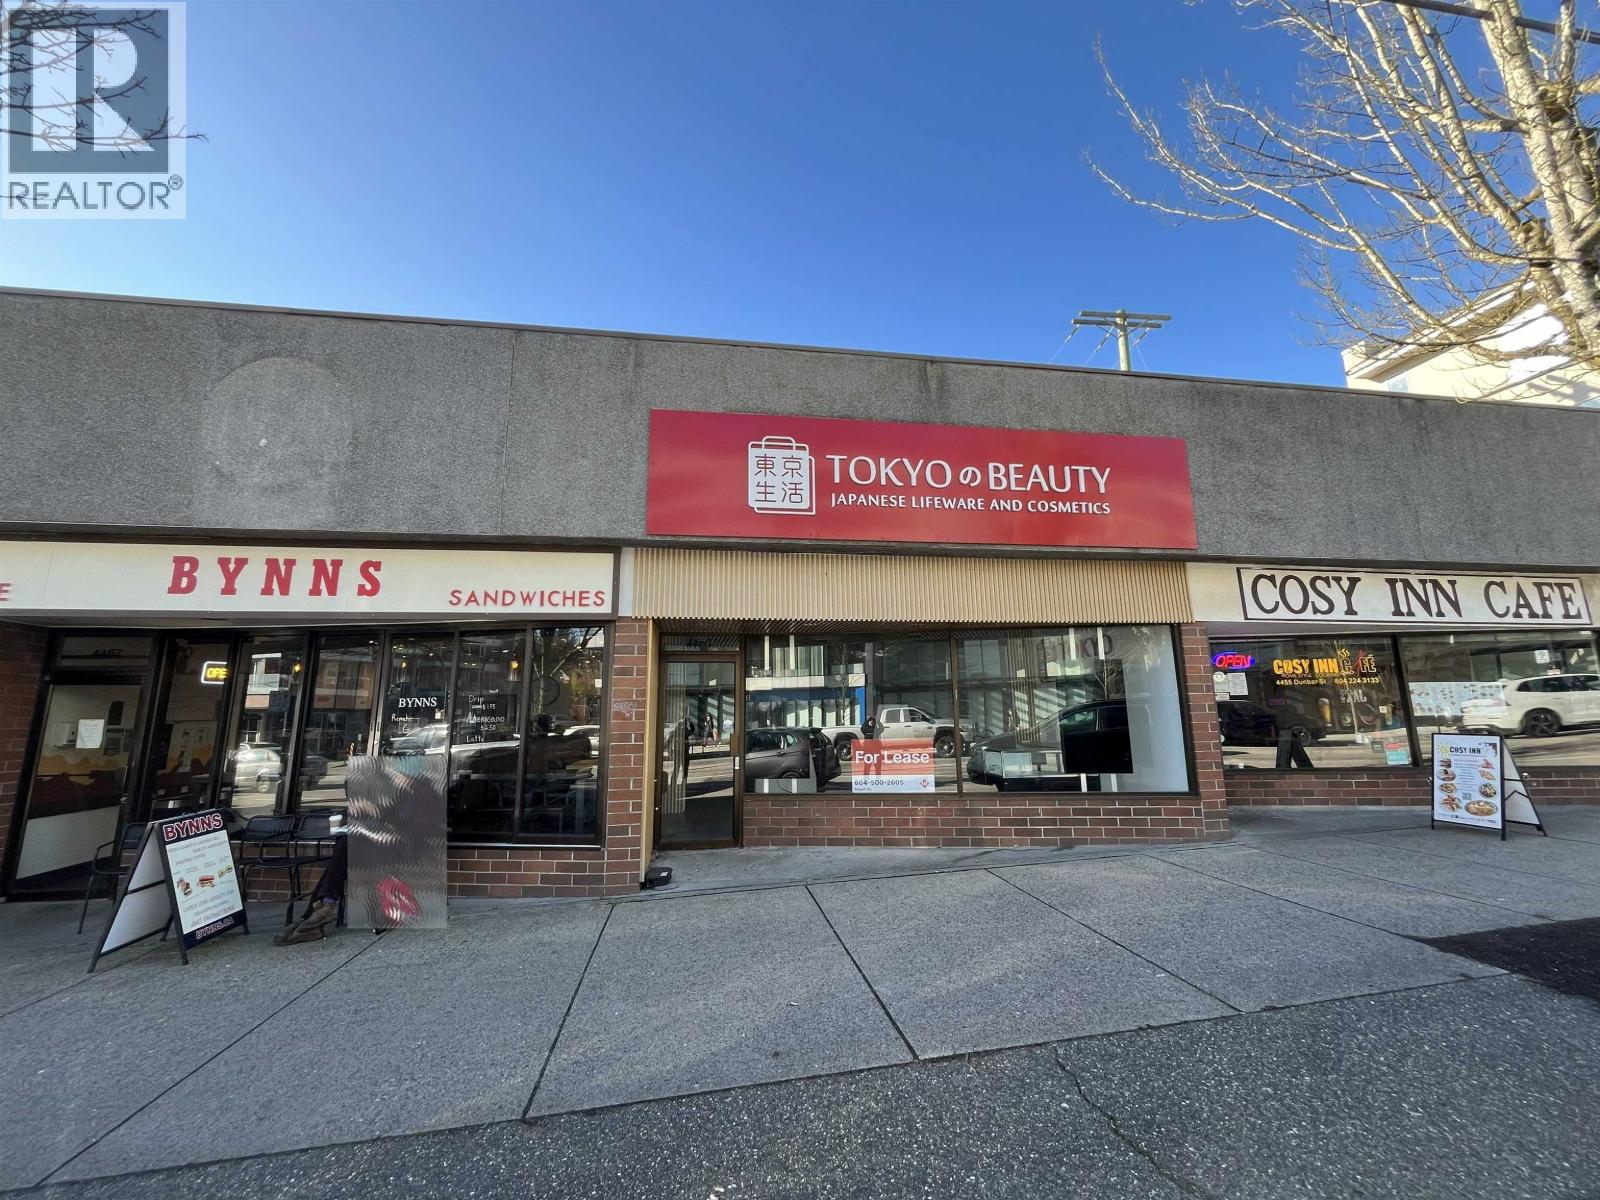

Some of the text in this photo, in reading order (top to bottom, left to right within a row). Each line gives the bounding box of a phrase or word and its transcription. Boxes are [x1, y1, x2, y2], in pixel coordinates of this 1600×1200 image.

[754, 453, 804, 478] 東京
[826, 454, 1111, 494] TOKYO の BEAUTY
[754, 480, 804, 504] 生活
[830, 492, 1111, 515] JAPANESE LIFEWARE AND COSMETICS
[167, 555, 383, 597] BYNNS
[449, 589, 606, 608] SANDWICHES
[1250, 573, 1582, 620] COSY INN CAFE
[1215, 654, 1252, 669] OPEN
[1273, 659, 1310, 674] COSY
[1313, 658, 1340, 673] INN
[206, 667, 229, 679] OPE
[398, 697, 437, 708] BYNNS
[468, 694, 484, 705] Drip
[855, 751, 930, 764] For Lease
[1449, 746, 1467, 754] COSY
[163, 813, 223, 842] BYNNS
